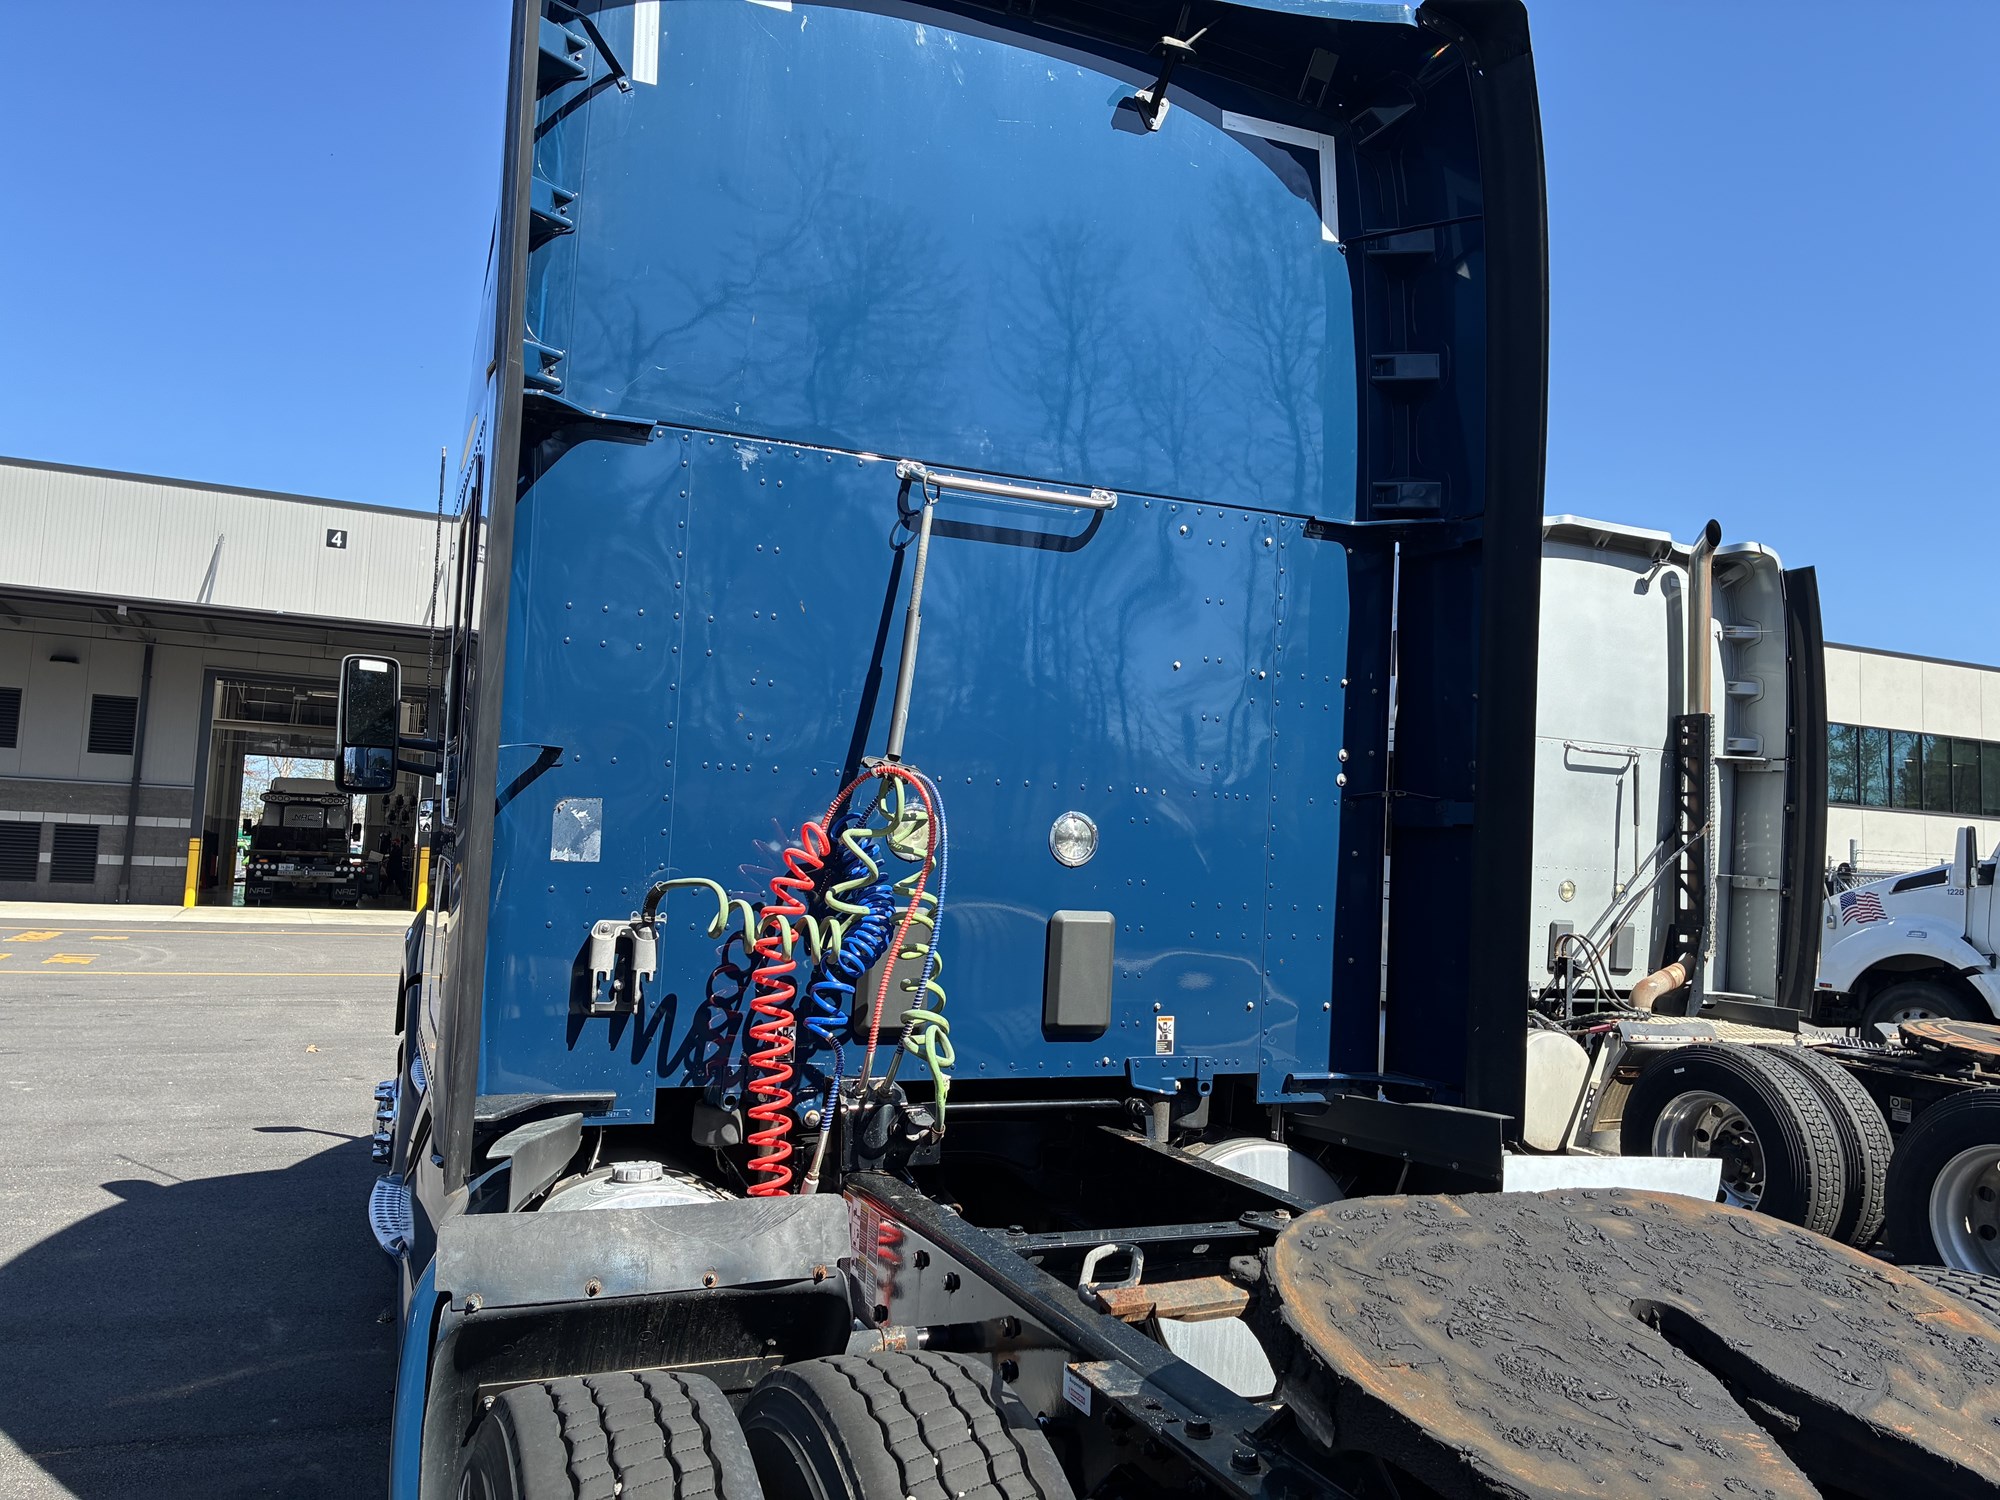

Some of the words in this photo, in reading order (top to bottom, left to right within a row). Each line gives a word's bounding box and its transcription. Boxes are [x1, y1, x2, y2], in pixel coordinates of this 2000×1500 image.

[331, 531, 343, 547] 4
[335, 888, 356, 896] NRC
[1946, 888, 1965, 896] 1228
